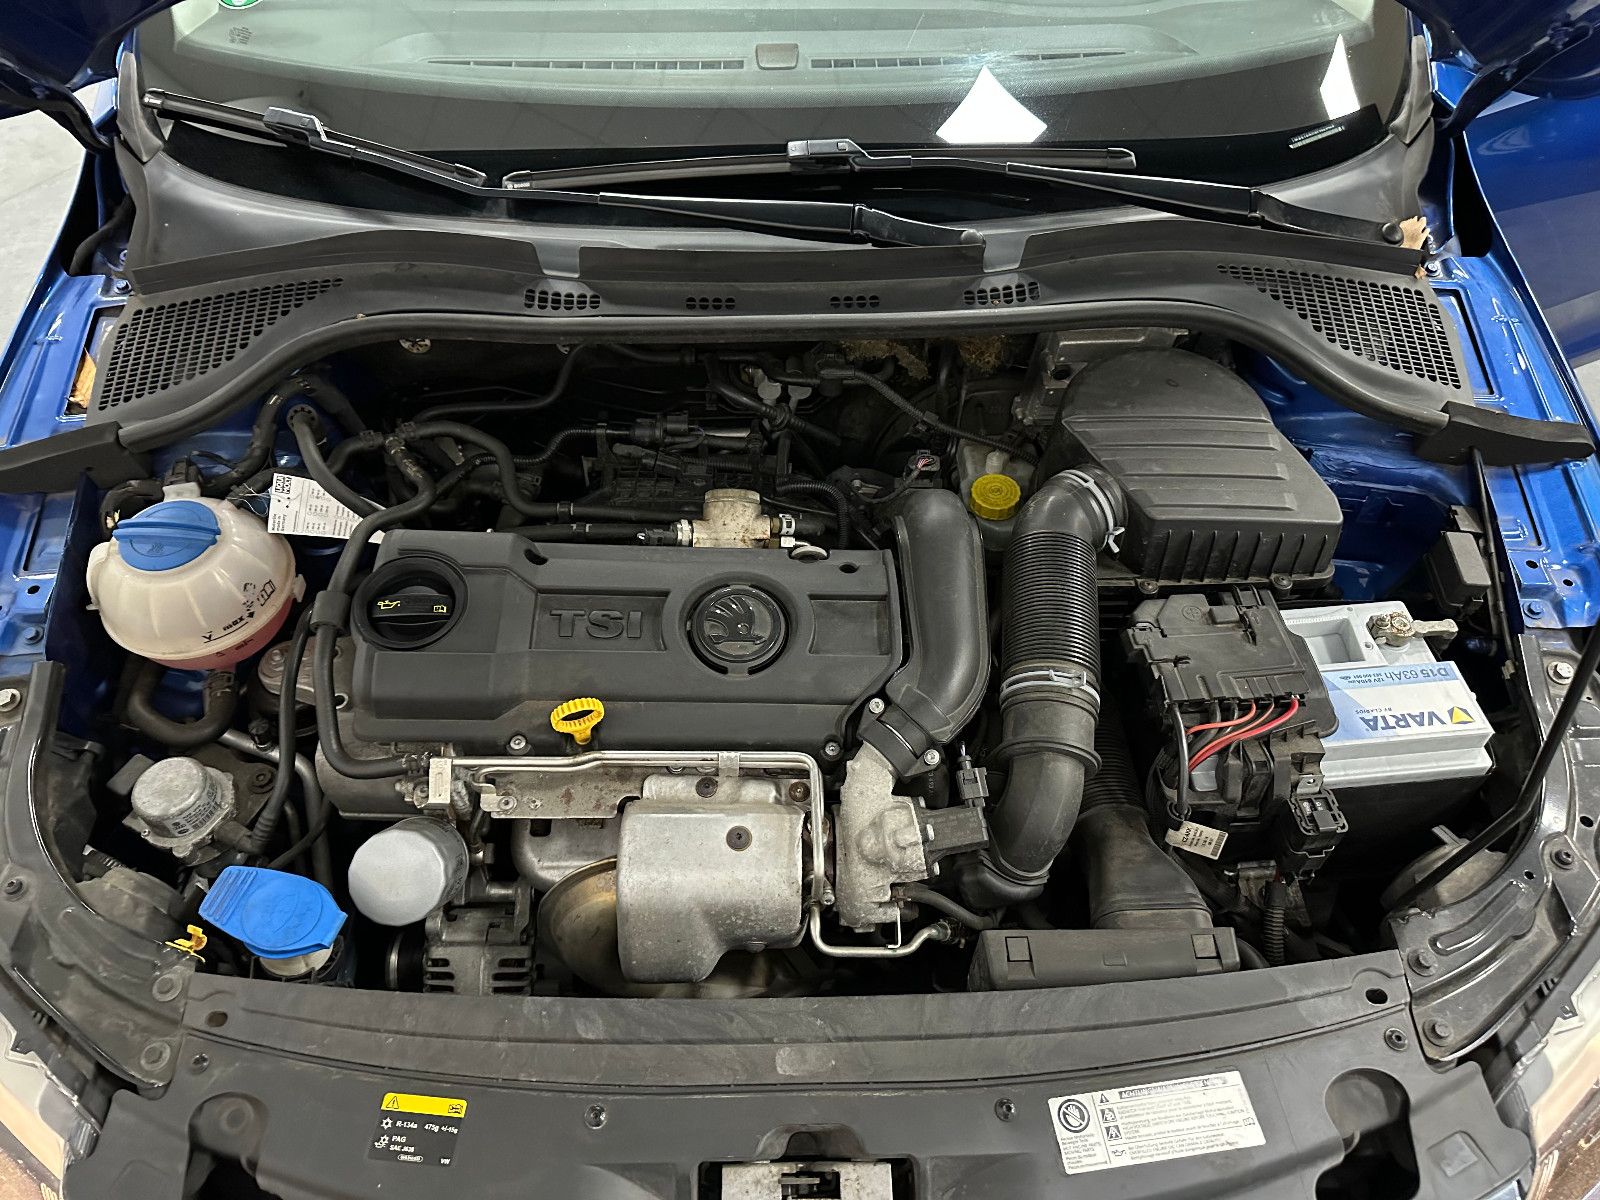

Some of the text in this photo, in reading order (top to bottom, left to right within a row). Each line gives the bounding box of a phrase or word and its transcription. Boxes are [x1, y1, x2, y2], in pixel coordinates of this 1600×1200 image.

[223, 616, 244, 630] max
[550, 609, 643, 639] TSI
[1384, 667, 1449, 681] D15 63Ah
[1359, 711, 1447, 732] VARTA
[395, 1120, 418, 1129] R-134a
[424, 1123, 440, 1133] 475g
[391, 1135, 407, 1143] PAG
